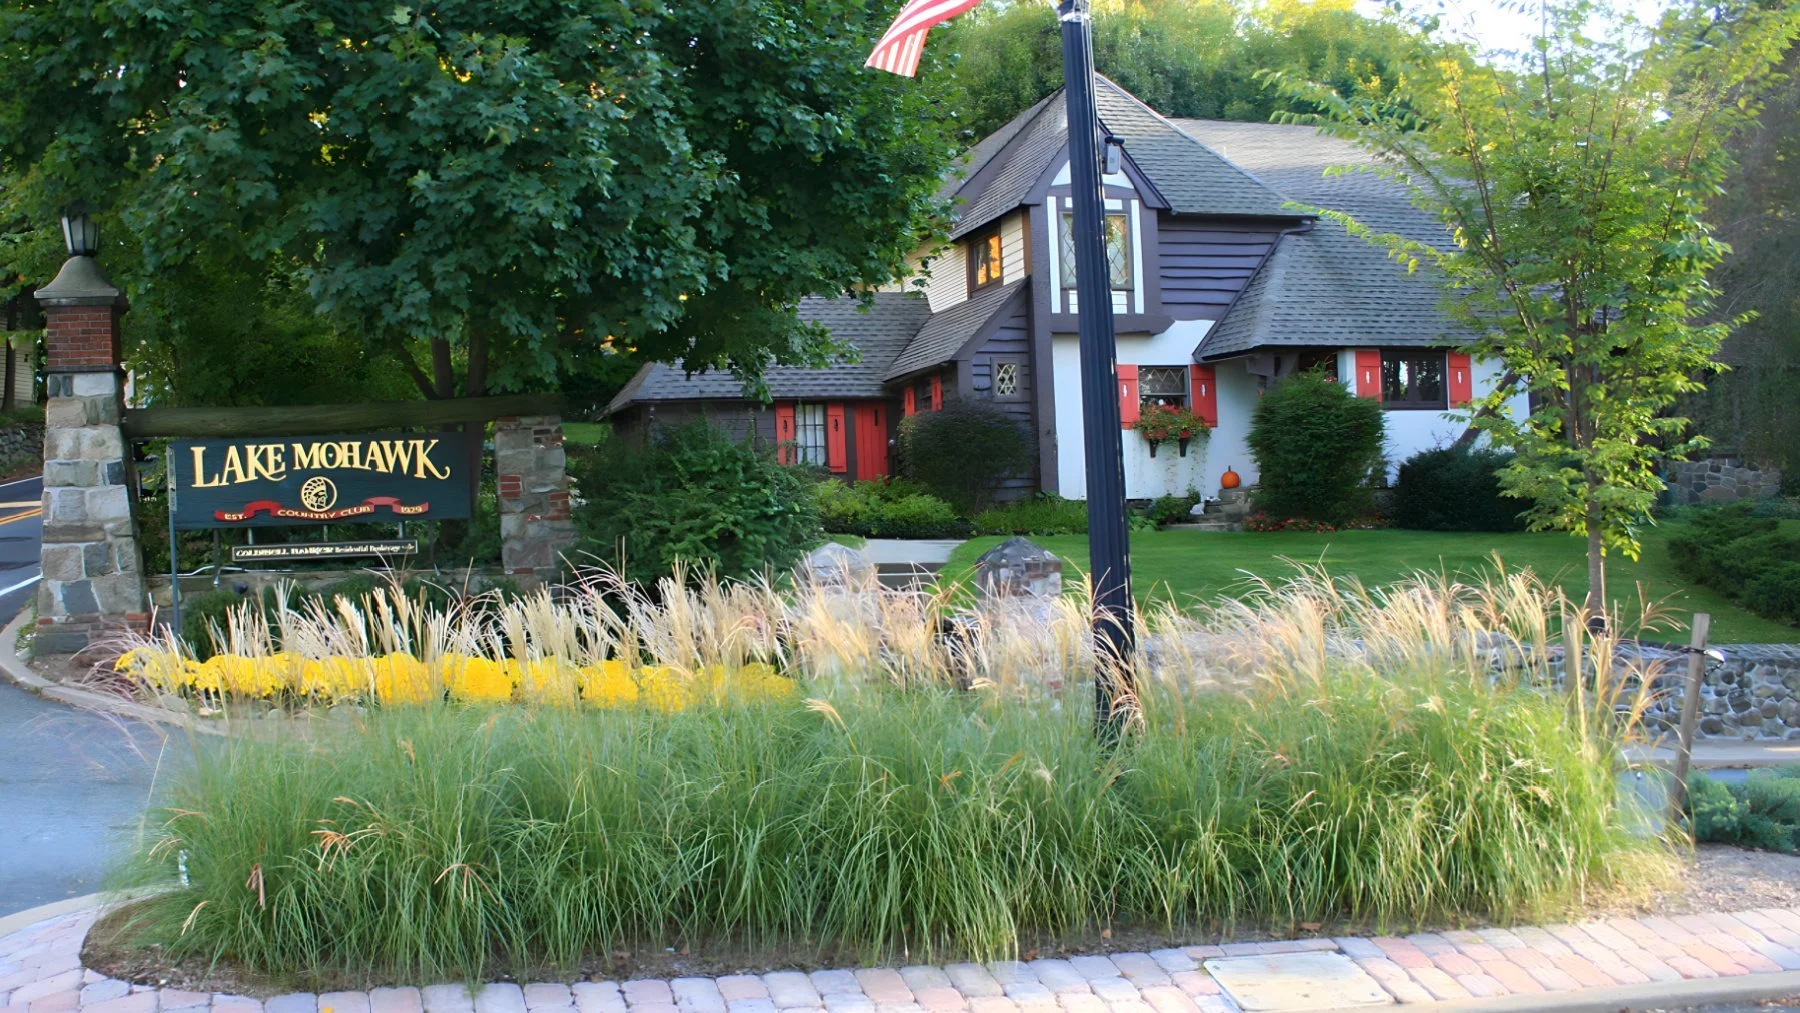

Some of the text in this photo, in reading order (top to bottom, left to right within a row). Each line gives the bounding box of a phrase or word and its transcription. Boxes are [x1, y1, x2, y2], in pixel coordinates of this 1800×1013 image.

[190, 443, 287, 489] LAKE
[291, 439, 451, 480] MOHAWK
[276, 509, 337, 519] COUNTRY
[340, 505, 372, 517] CLUB
